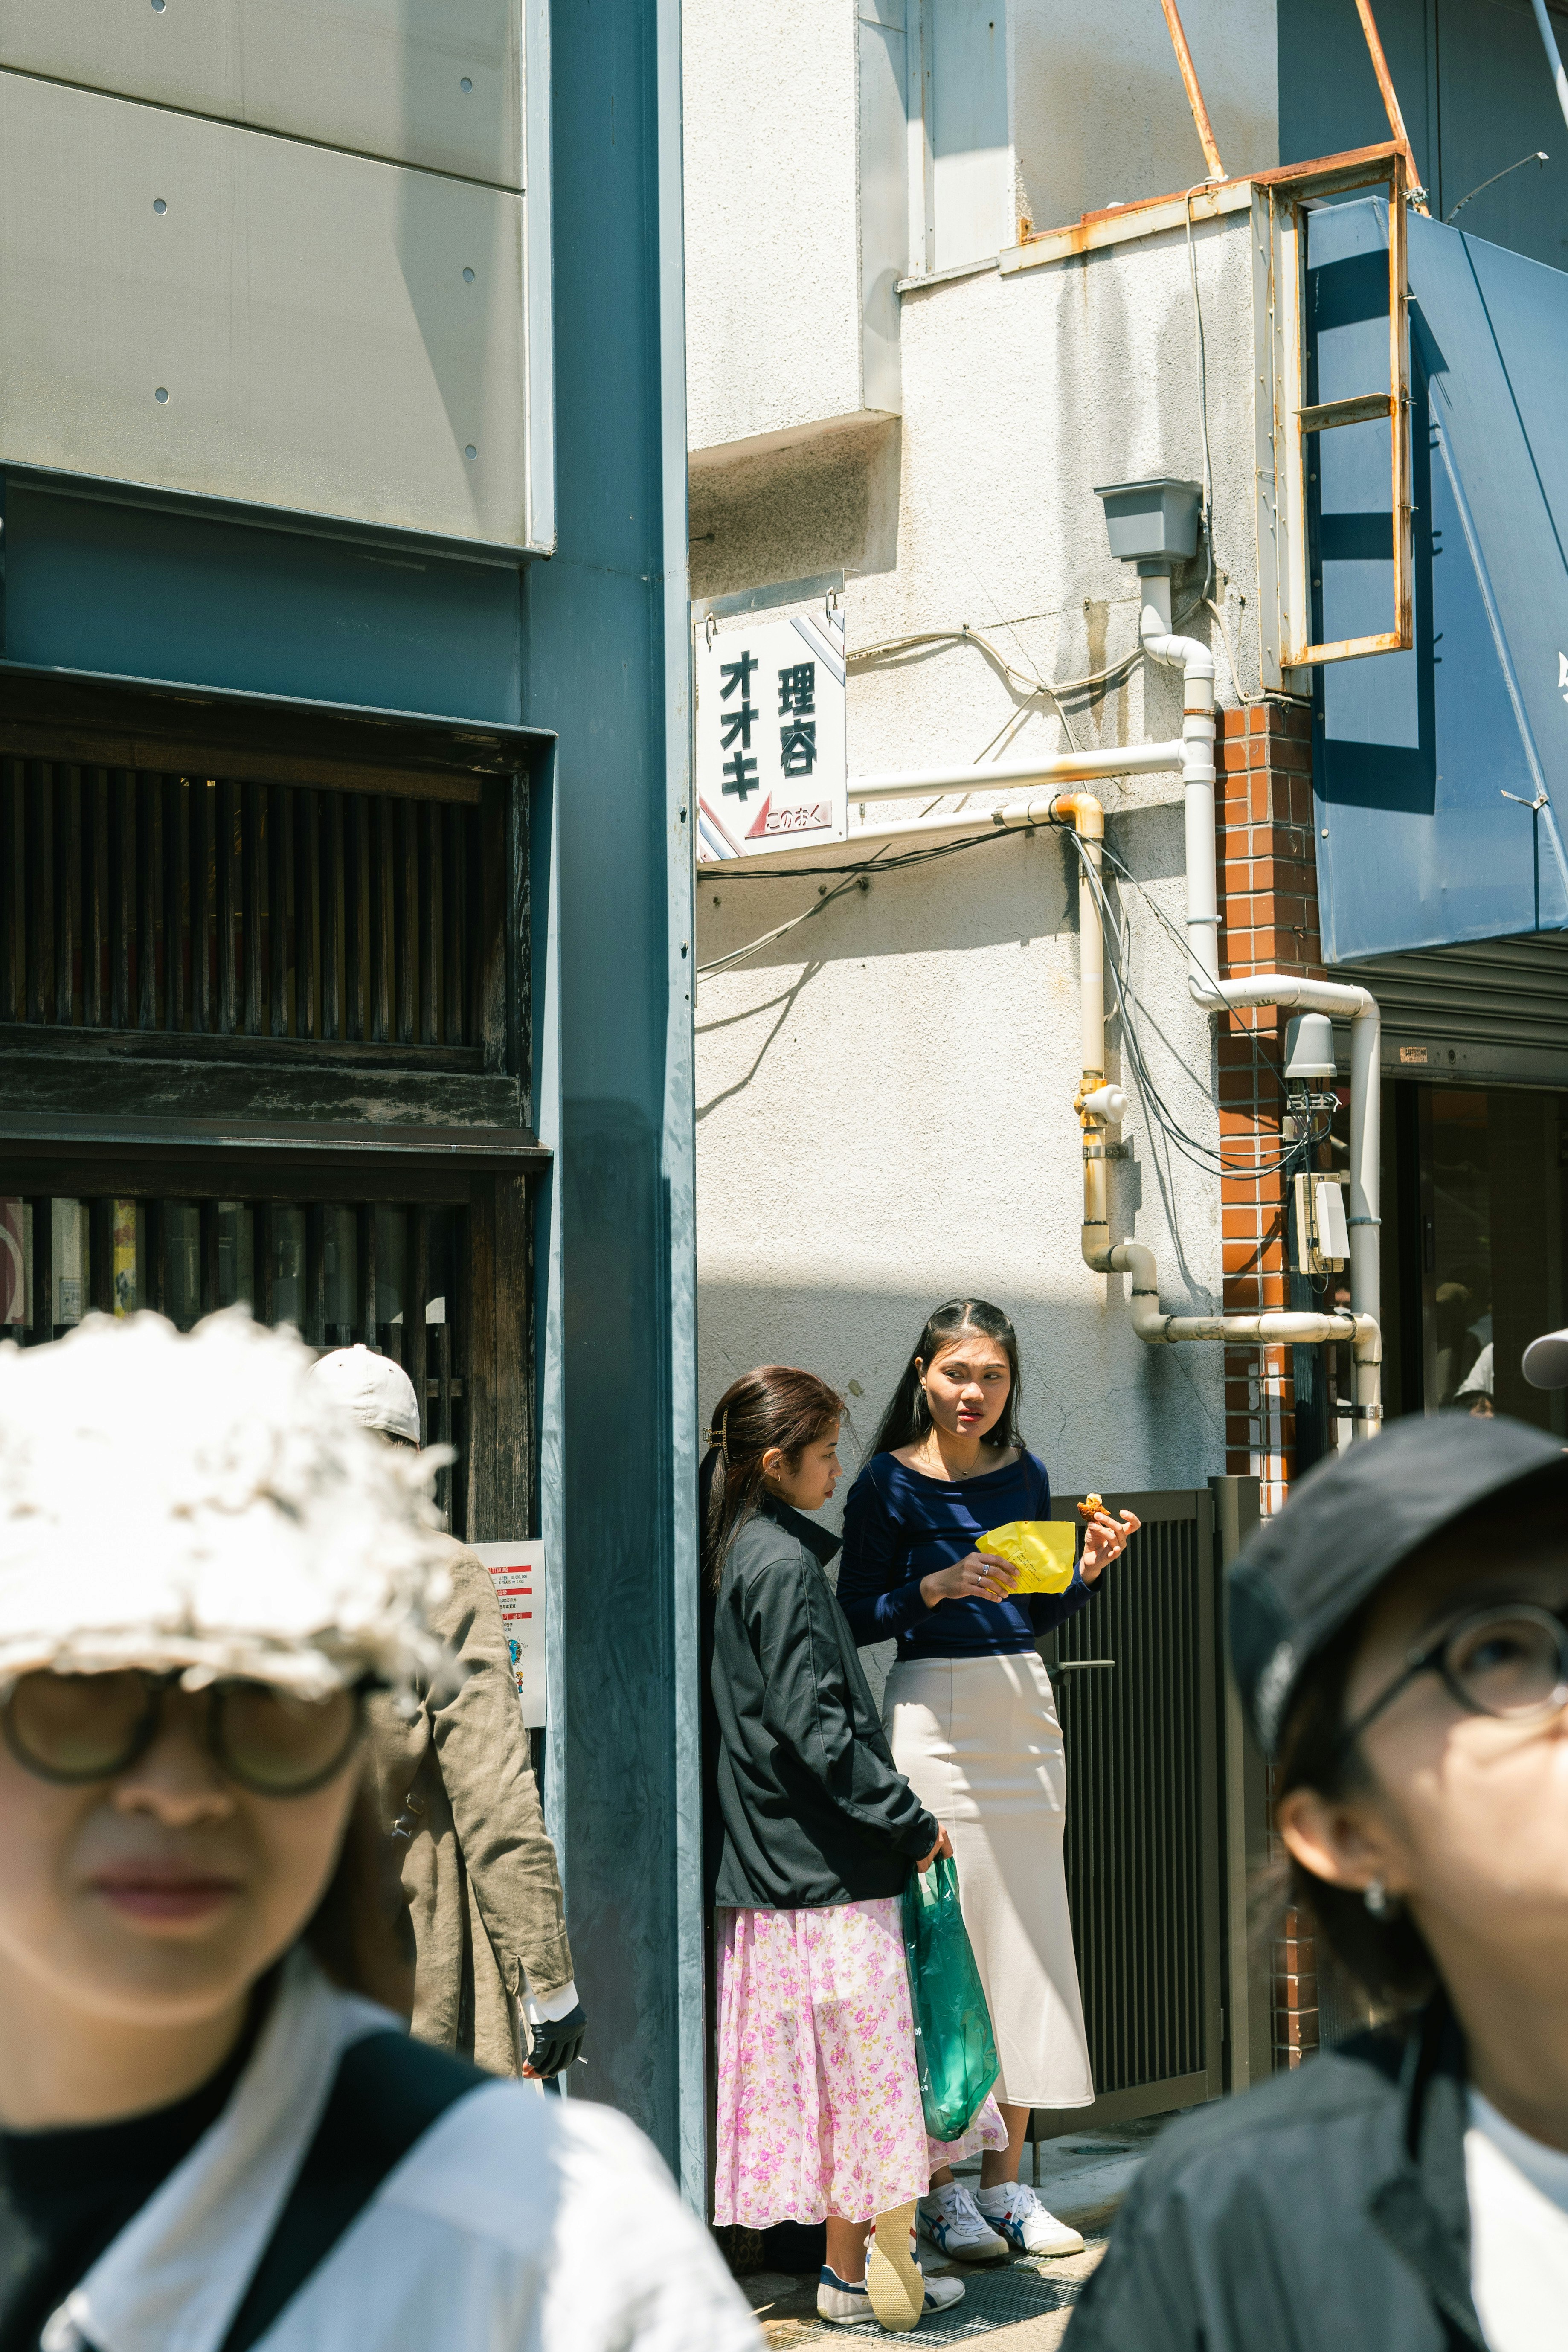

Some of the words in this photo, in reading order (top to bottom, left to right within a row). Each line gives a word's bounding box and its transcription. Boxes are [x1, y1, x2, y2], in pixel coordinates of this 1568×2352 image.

[720, 650, 759, 802] オオキ
[778, 661, 817, 779] 理容
[767, 804, 821, 830] このおく
